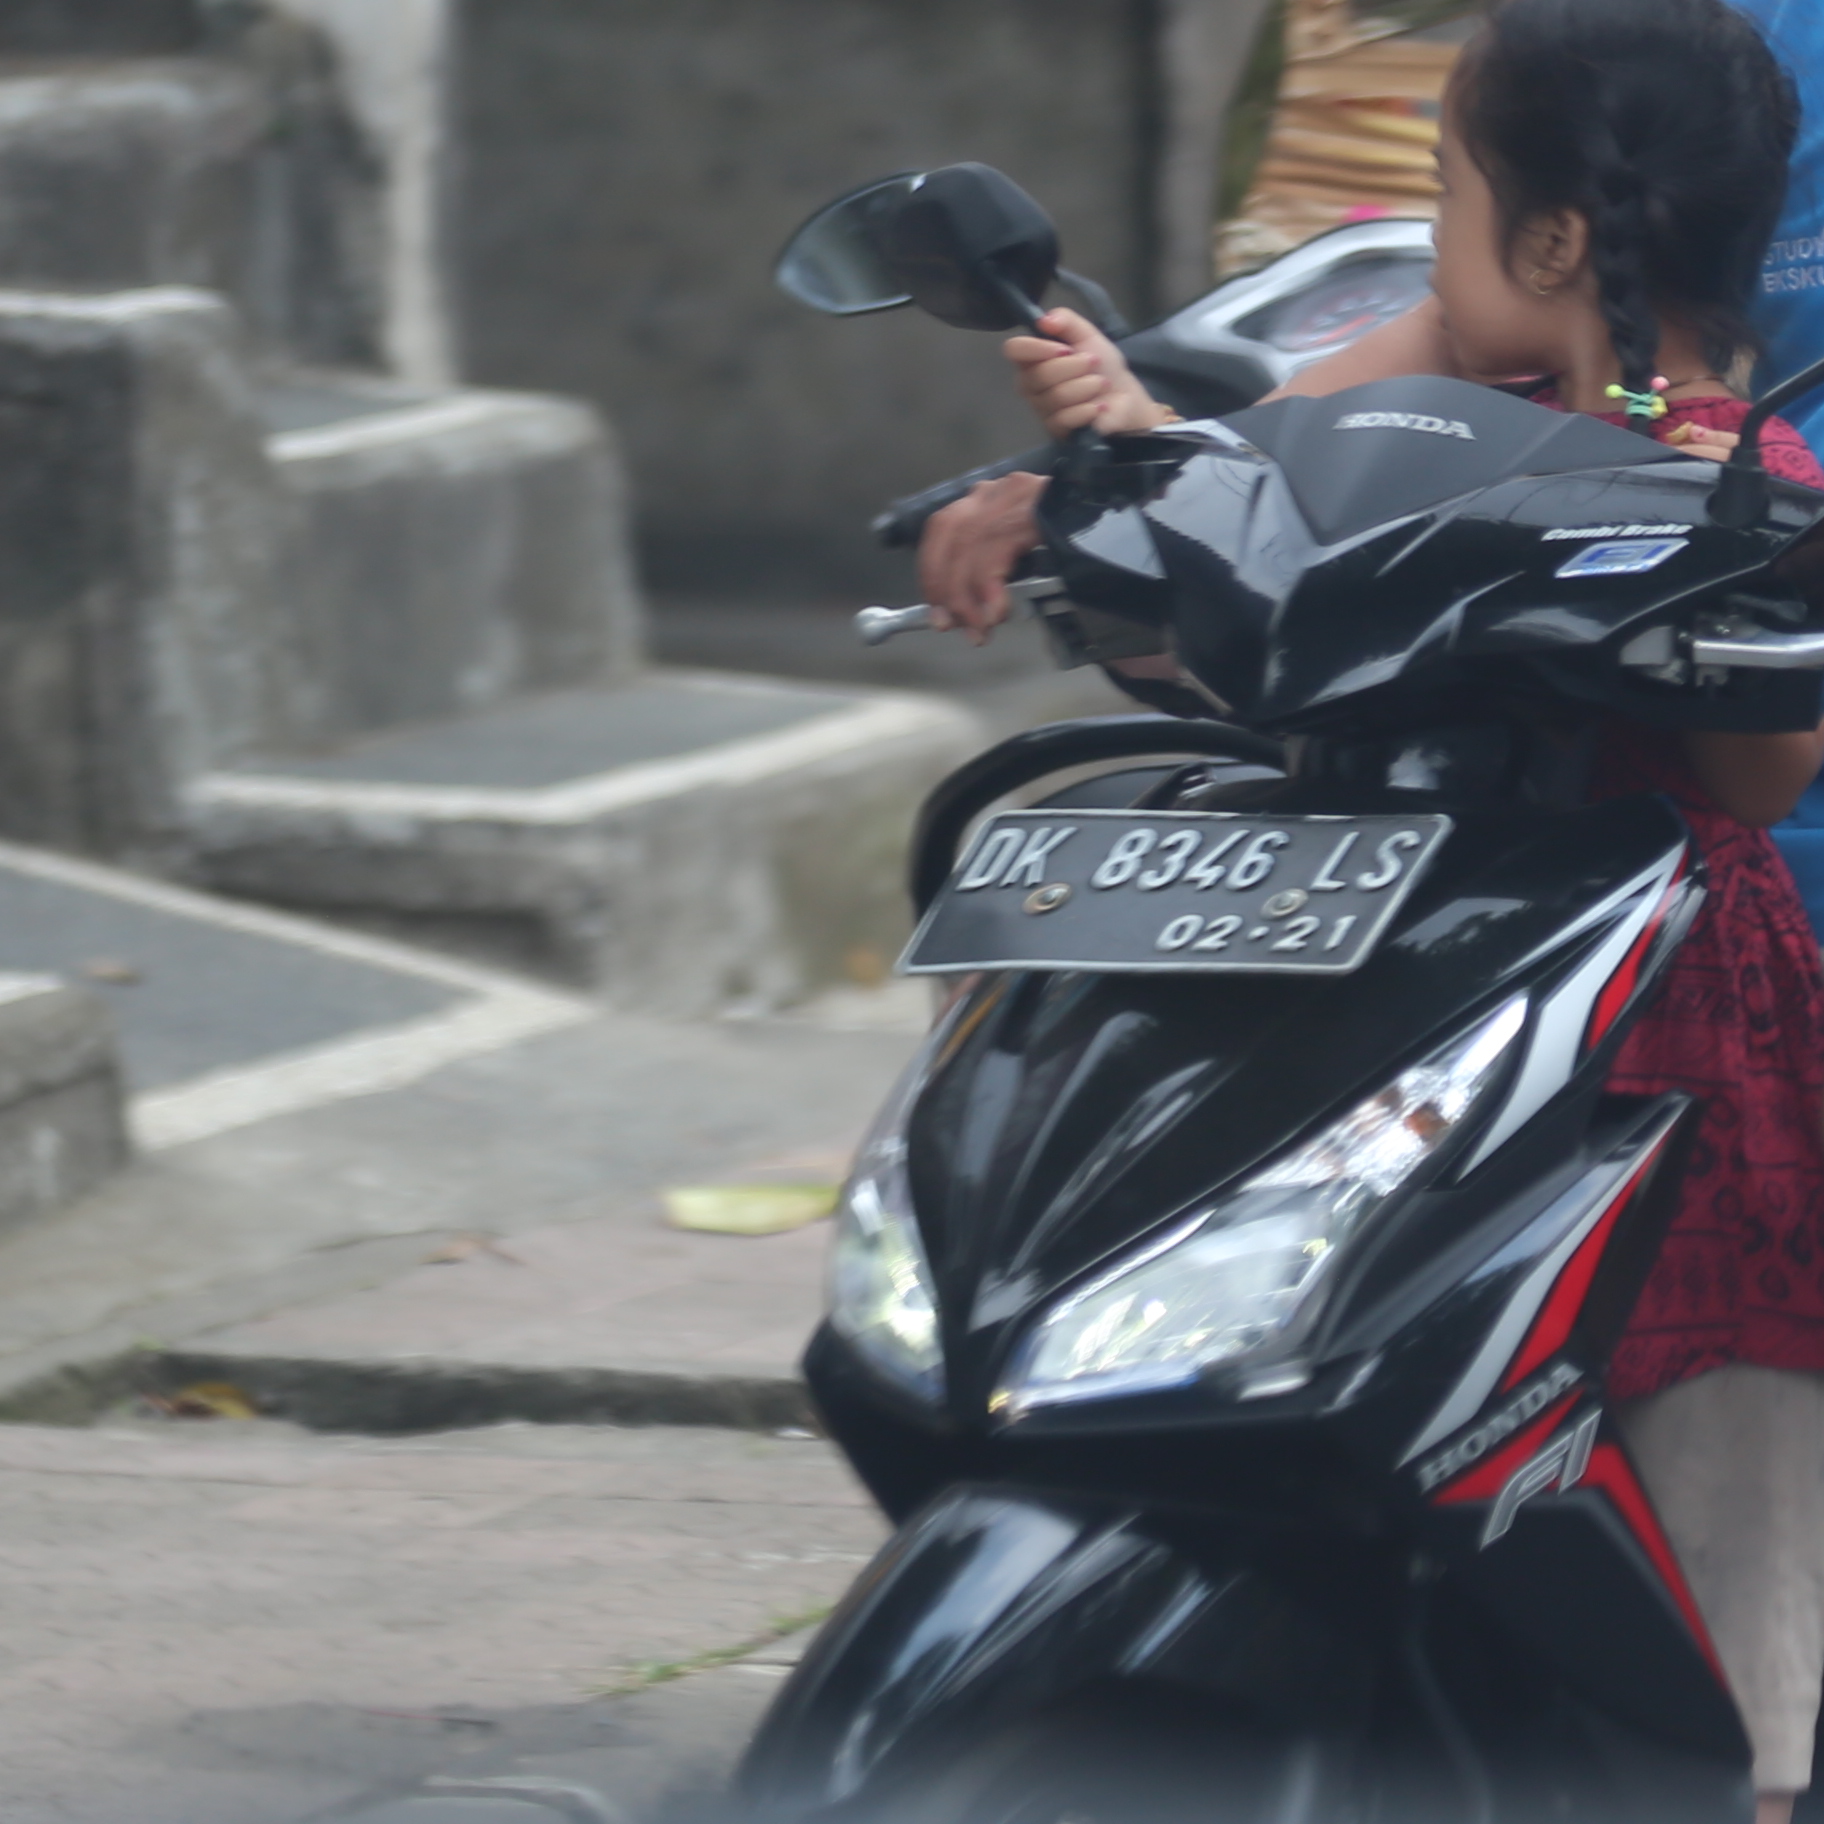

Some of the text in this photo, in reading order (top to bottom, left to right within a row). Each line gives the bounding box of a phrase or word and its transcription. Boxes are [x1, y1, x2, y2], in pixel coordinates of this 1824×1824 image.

[1332, 411, 1477, 442] HONDA
[1540, 523, 1694, 542] Combi Brake
[956, 825, 1422, 894] DK 8346 LS
[1416, 1362, 1585, 1496] HONDA
[1478, 1407, 1604, 1553] FI
